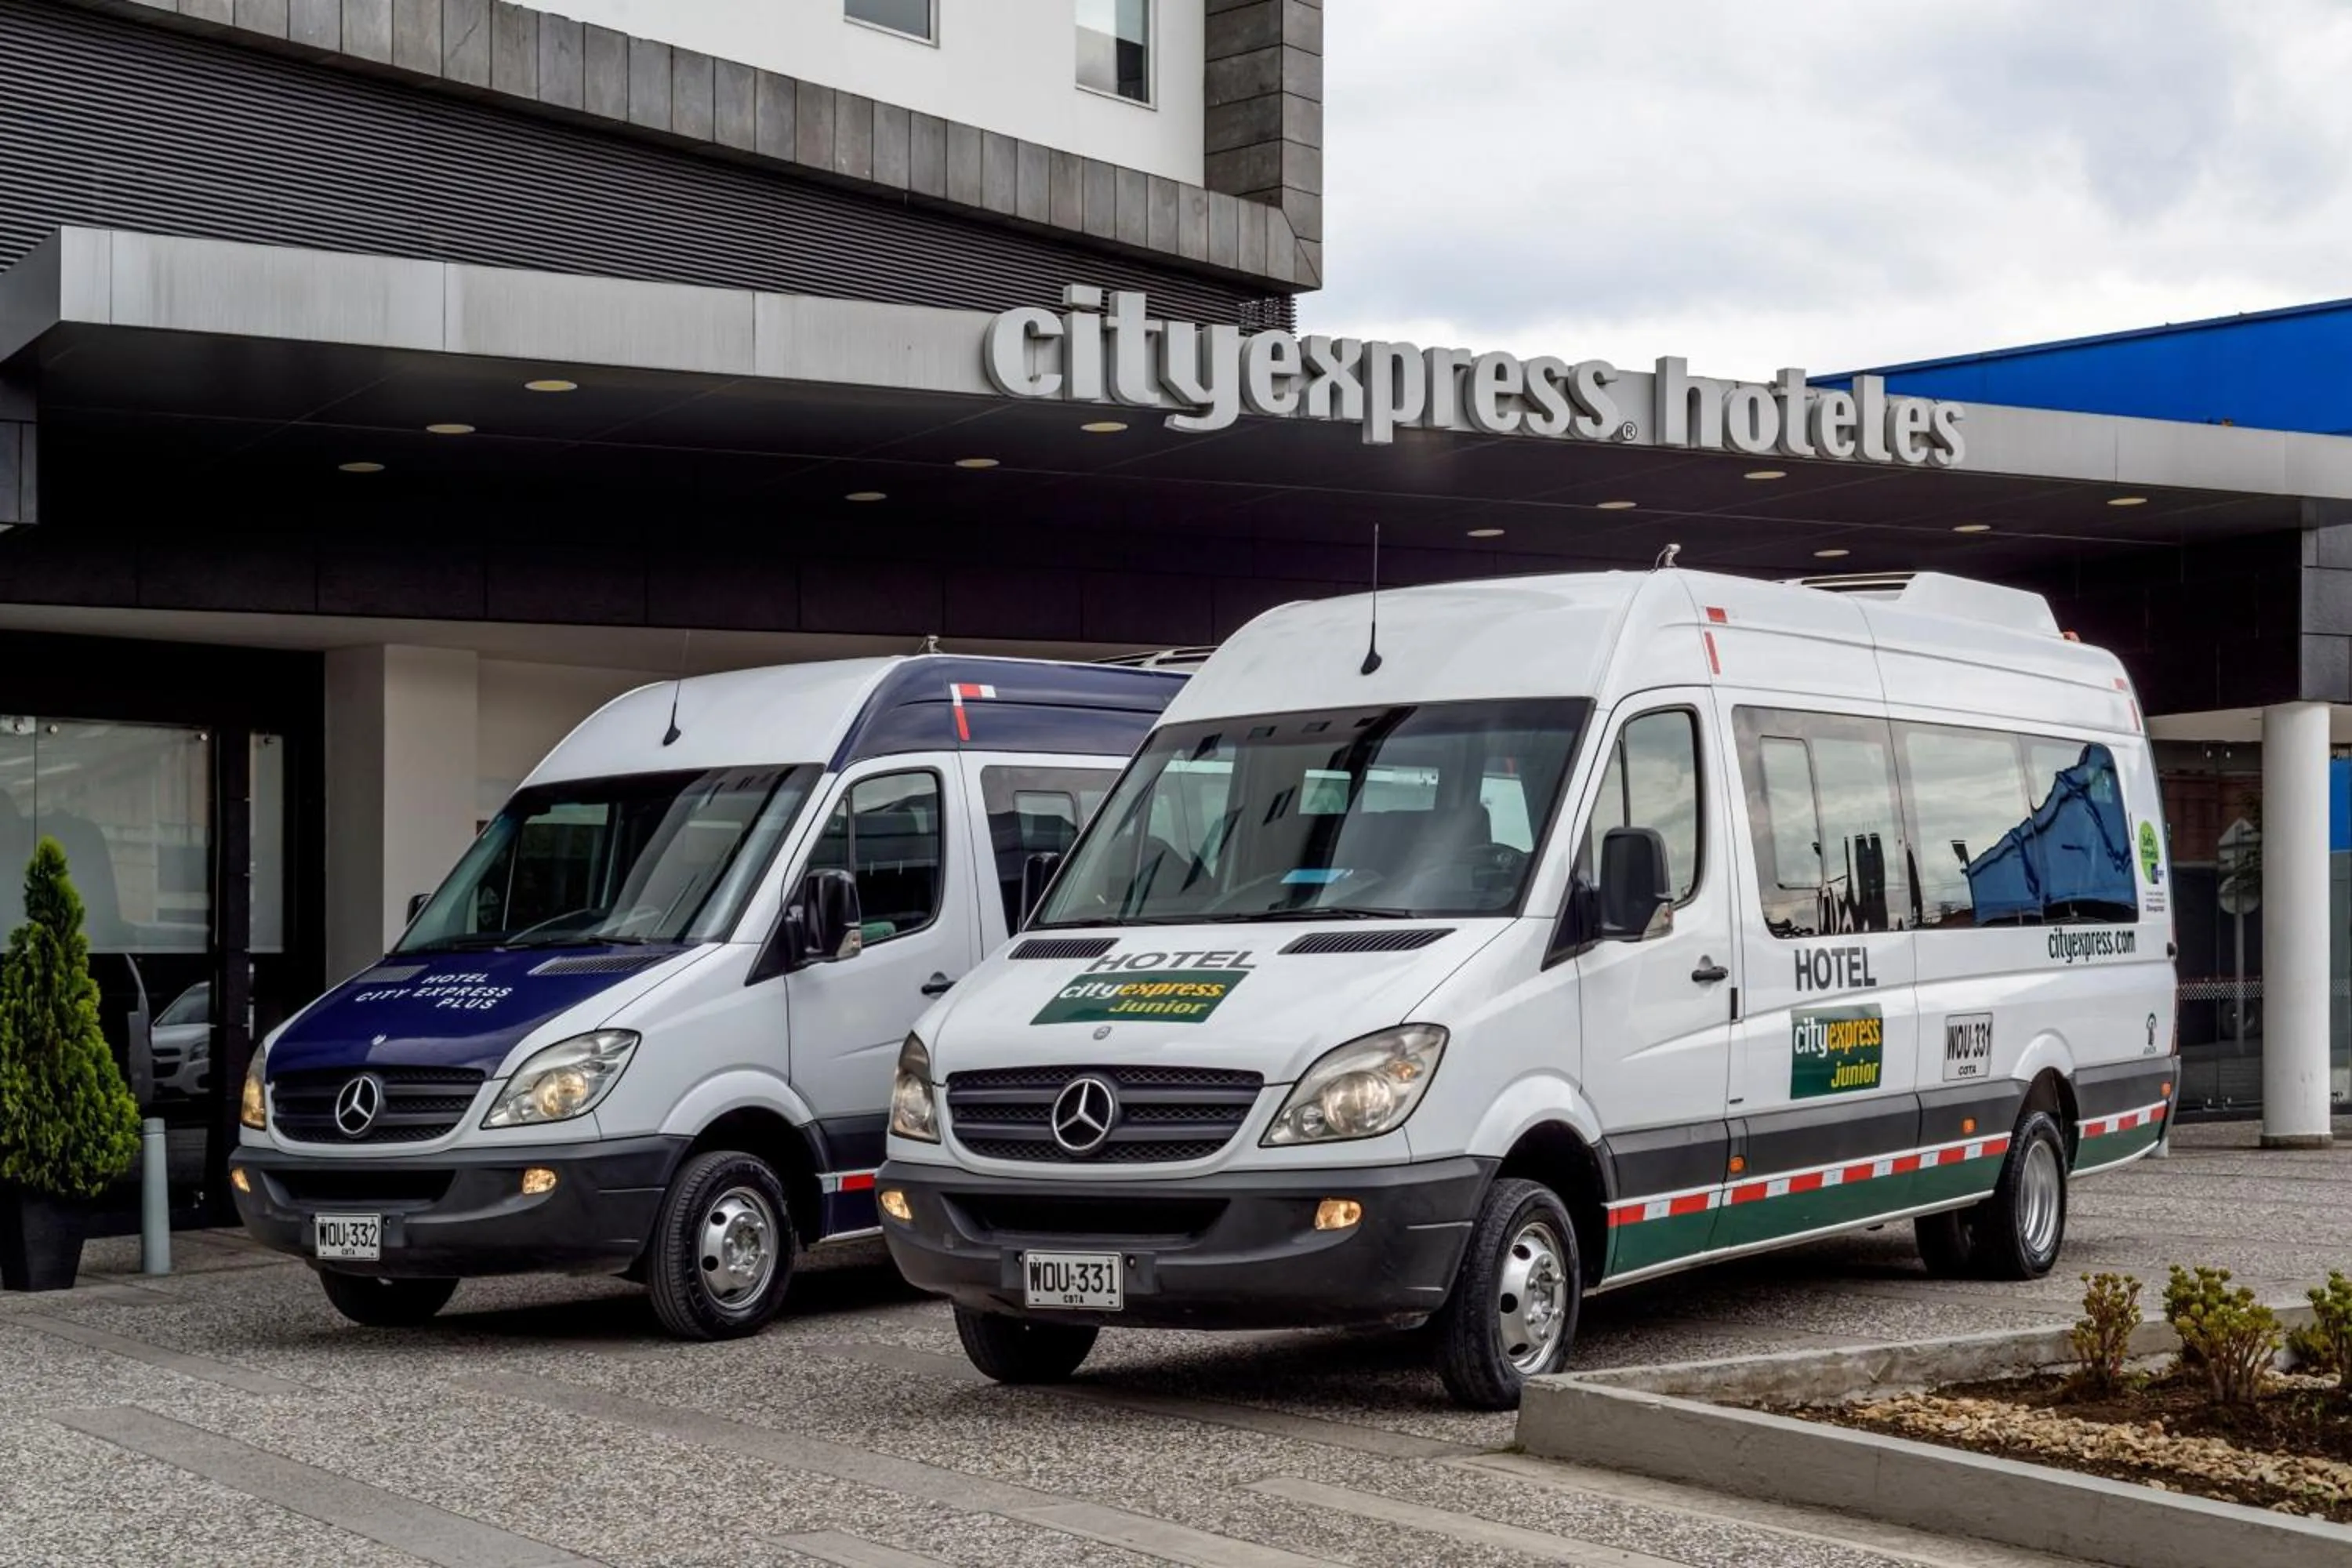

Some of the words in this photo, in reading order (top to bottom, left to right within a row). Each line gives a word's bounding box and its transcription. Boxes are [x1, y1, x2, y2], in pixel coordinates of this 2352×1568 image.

[1655, 355, 1966, 468] hoteles
[2048, 927, 2136, 964] cityexpress.com
[1085, 950, 1257, 973] HOTEL
[1795, 947, 1877, 992] HOTEL
[421, 973, 489, 985] HOTEL
[1058, 981, 1226, 1000] cityexpress
[354, 988, 412, 1002] CITY
[412, 986, 514, 998] EXPRESS
[436, 997, 497, 1010] PLUS
[1109, 998, 1209, 1014] junior
[1795, 1016, 1880, 1058] cityexpress
[1947, 1022, 1991, 1061] WOU-331
[1831, 1058, 1879, 1088] junior
